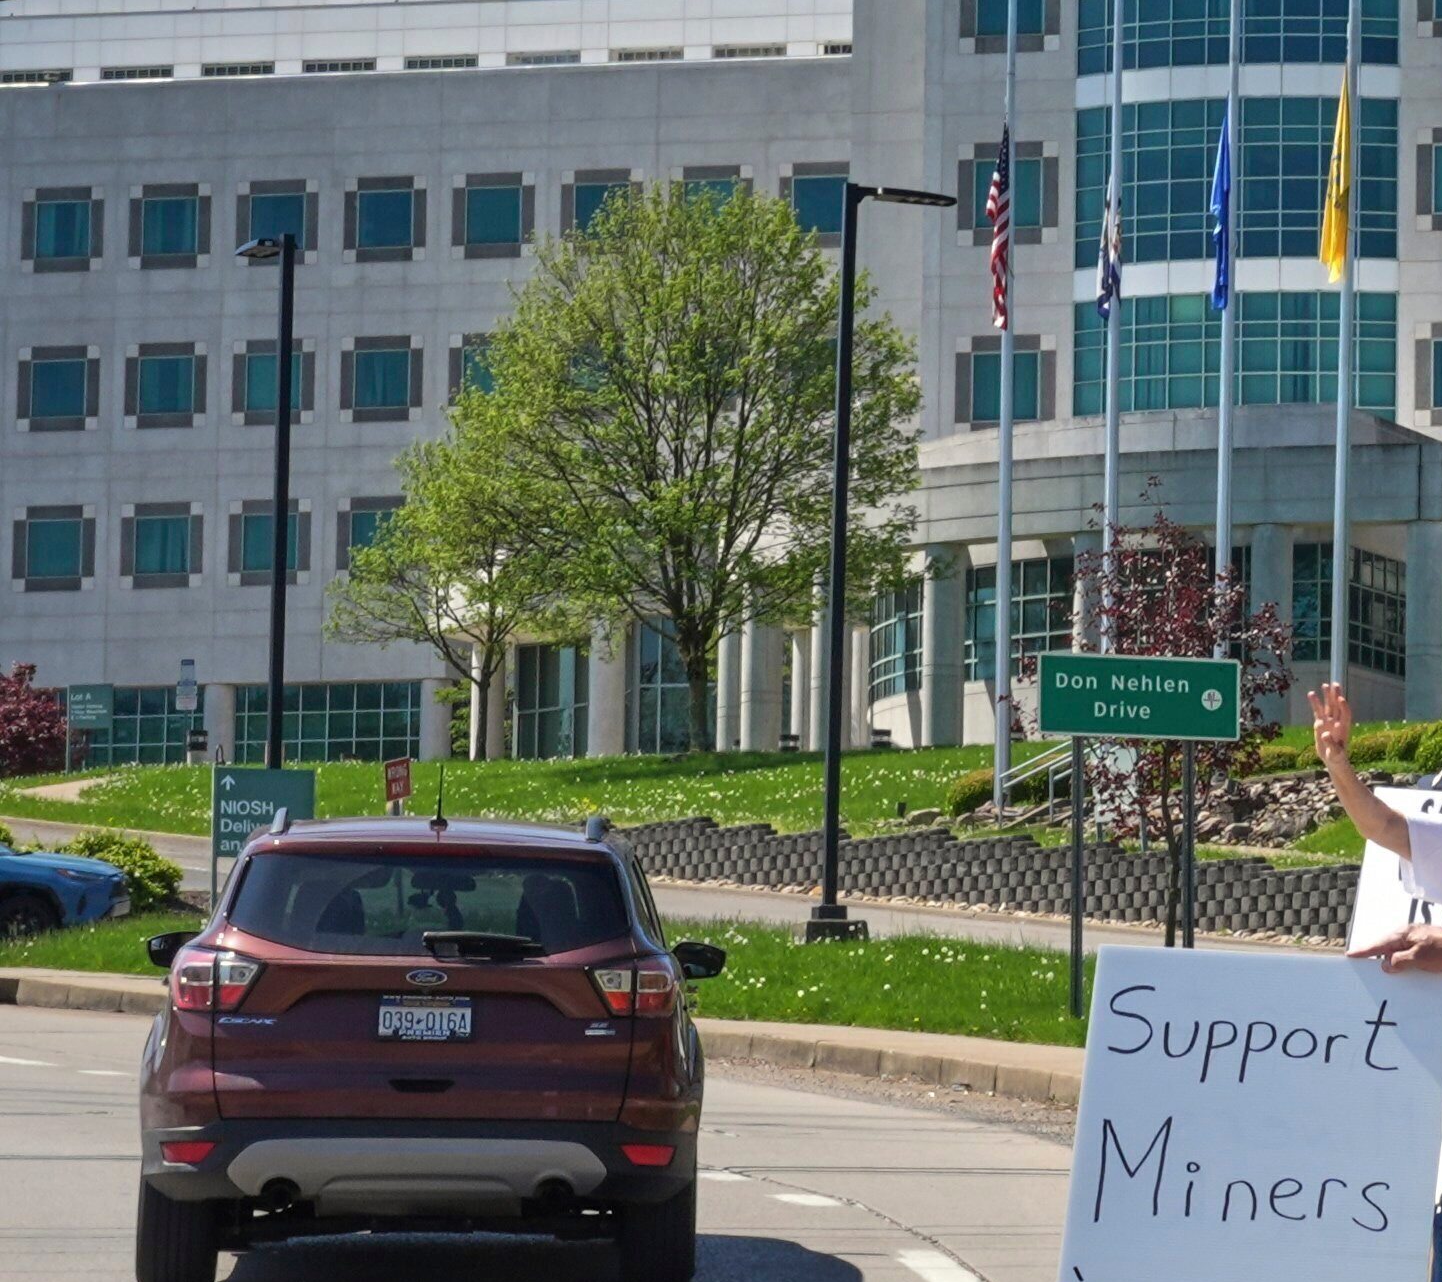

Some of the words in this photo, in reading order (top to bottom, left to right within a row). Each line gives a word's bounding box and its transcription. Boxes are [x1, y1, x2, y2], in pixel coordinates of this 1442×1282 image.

[1056, 672, 1098, 690] Don
[1111, 674, 1190, 694] Nehlen
[1094, 701, 1151, 720] Drive
[220, 800, 274, 815] NIOSH
[1107, 985, 1399, 1083] Support
[1093, 1116, 1391, 1232] Miners
